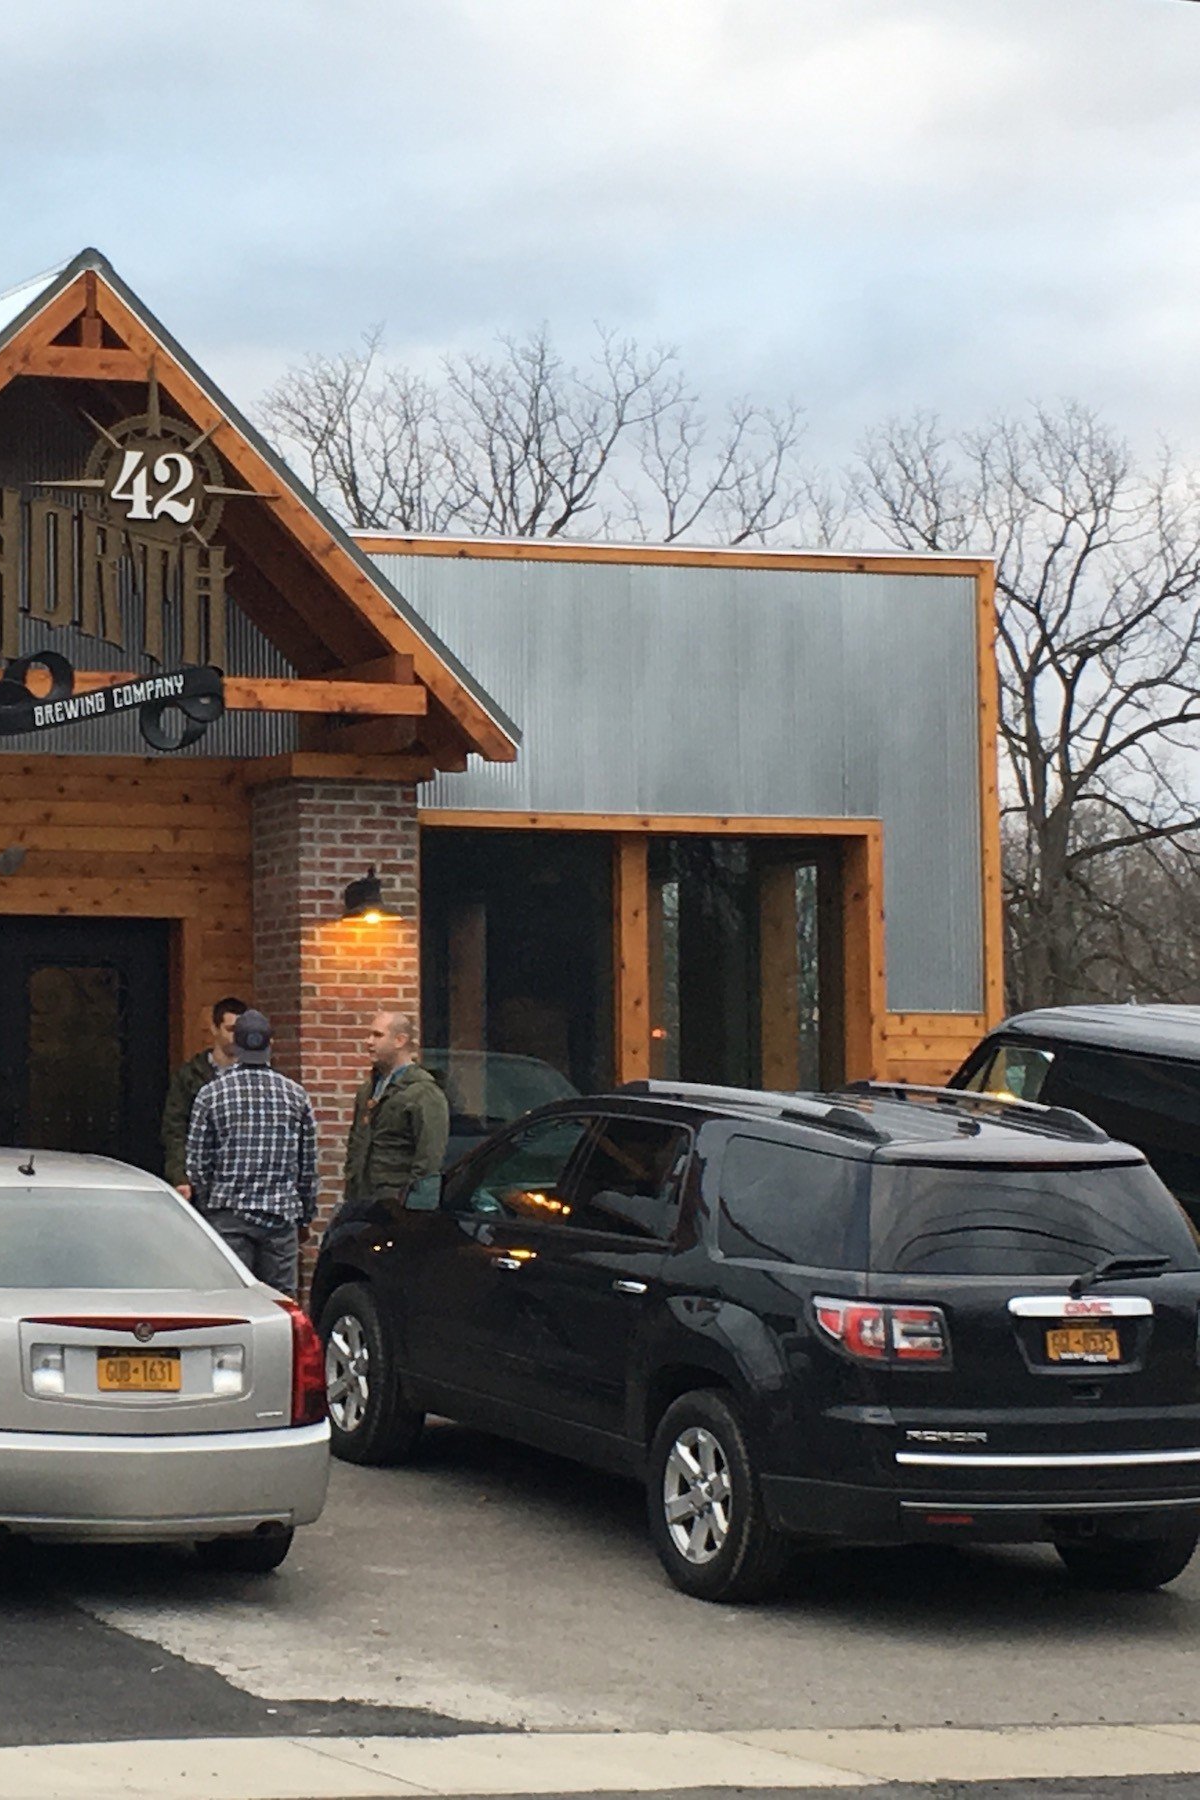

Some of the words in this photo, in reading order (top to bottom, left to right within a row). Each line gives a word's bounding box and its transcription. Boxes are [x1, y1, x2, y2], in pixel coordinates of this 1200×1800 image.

[111, 451, 195, 523] 42
[34, 692, 105, 726] BREWING
[113, 674, 184, 708] COMPANY
[1065, 1302, 1113, 1315] GMC
